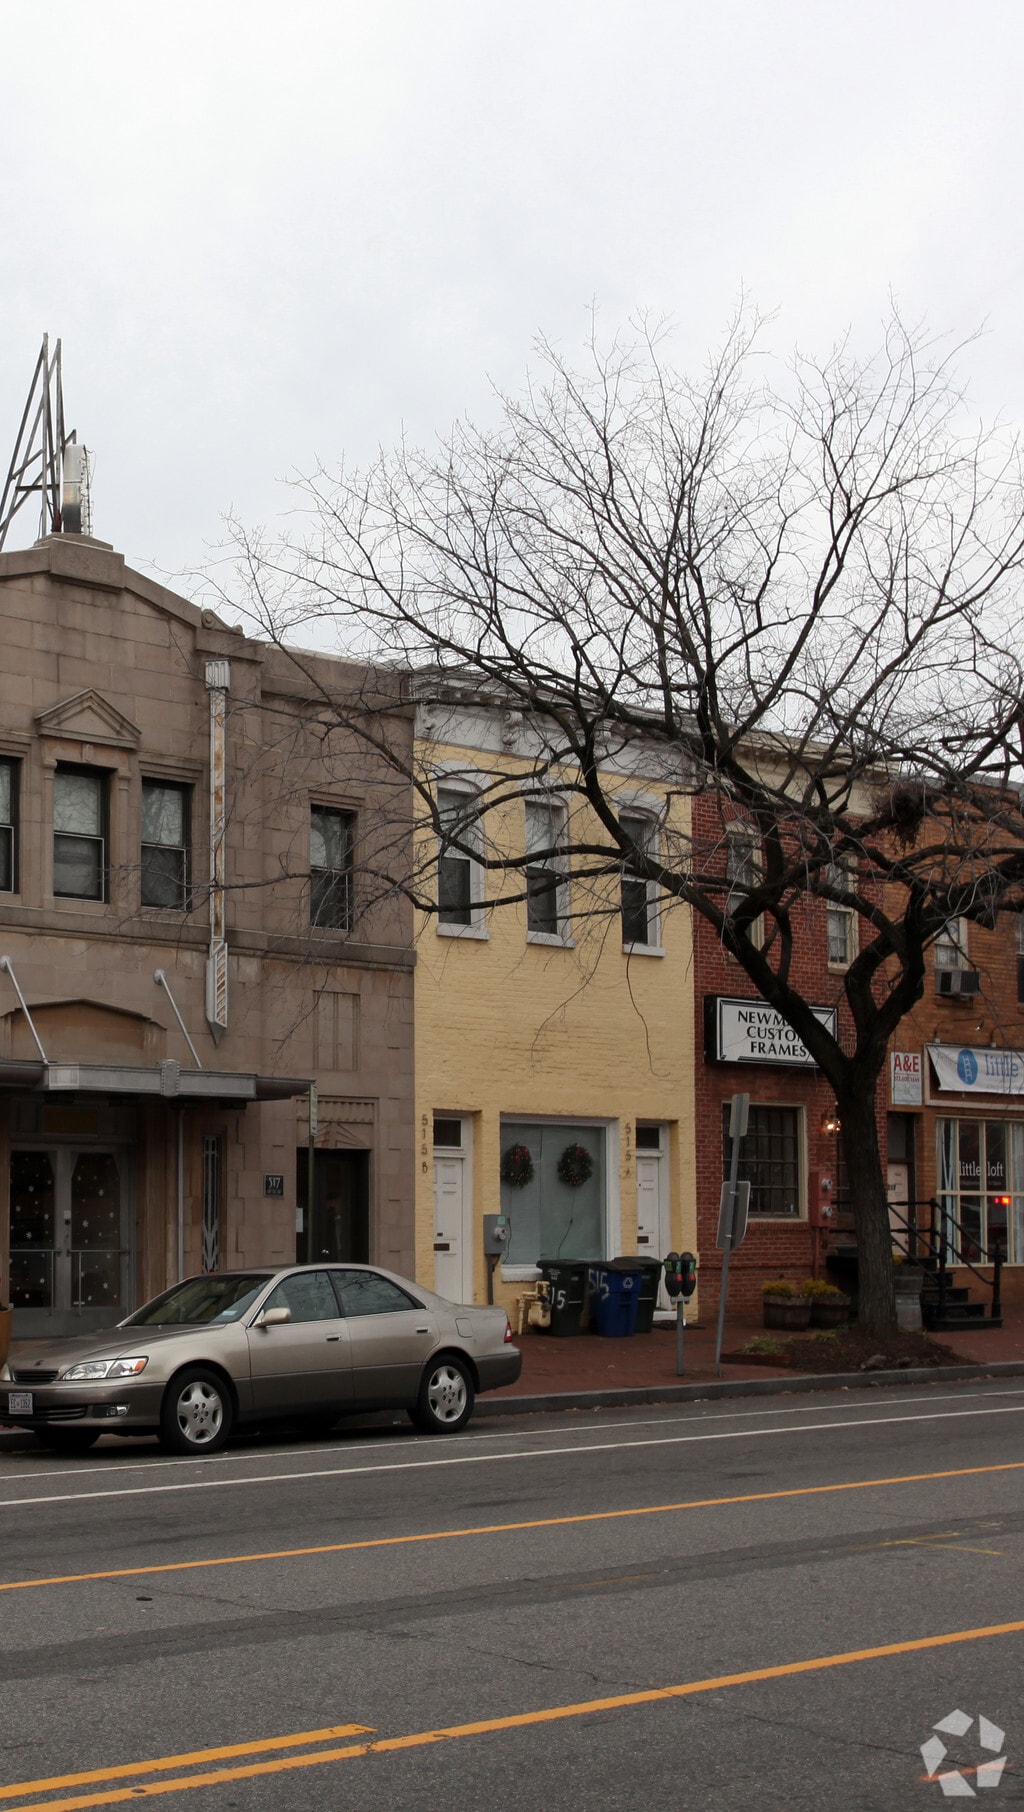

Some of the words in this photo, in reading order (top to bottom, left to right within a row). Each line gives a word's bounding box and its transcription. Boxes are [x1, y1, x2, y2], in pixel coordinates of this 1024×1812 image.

[746, 1026, 801, 1042] CUSTO
[750, 1042, 807, 1057] FRAMES
[894, 1054, 920, 1073] A&E
[985, 1055, 1019, 1077] little
[958, 1160, 982, 1177] little
[987, 1161, 1004, 1177] loft
[268, 1177, 281, 1189] 517
[588, 1269, 610, 1301] 515
[551, 1286, 567, 1310] 15
